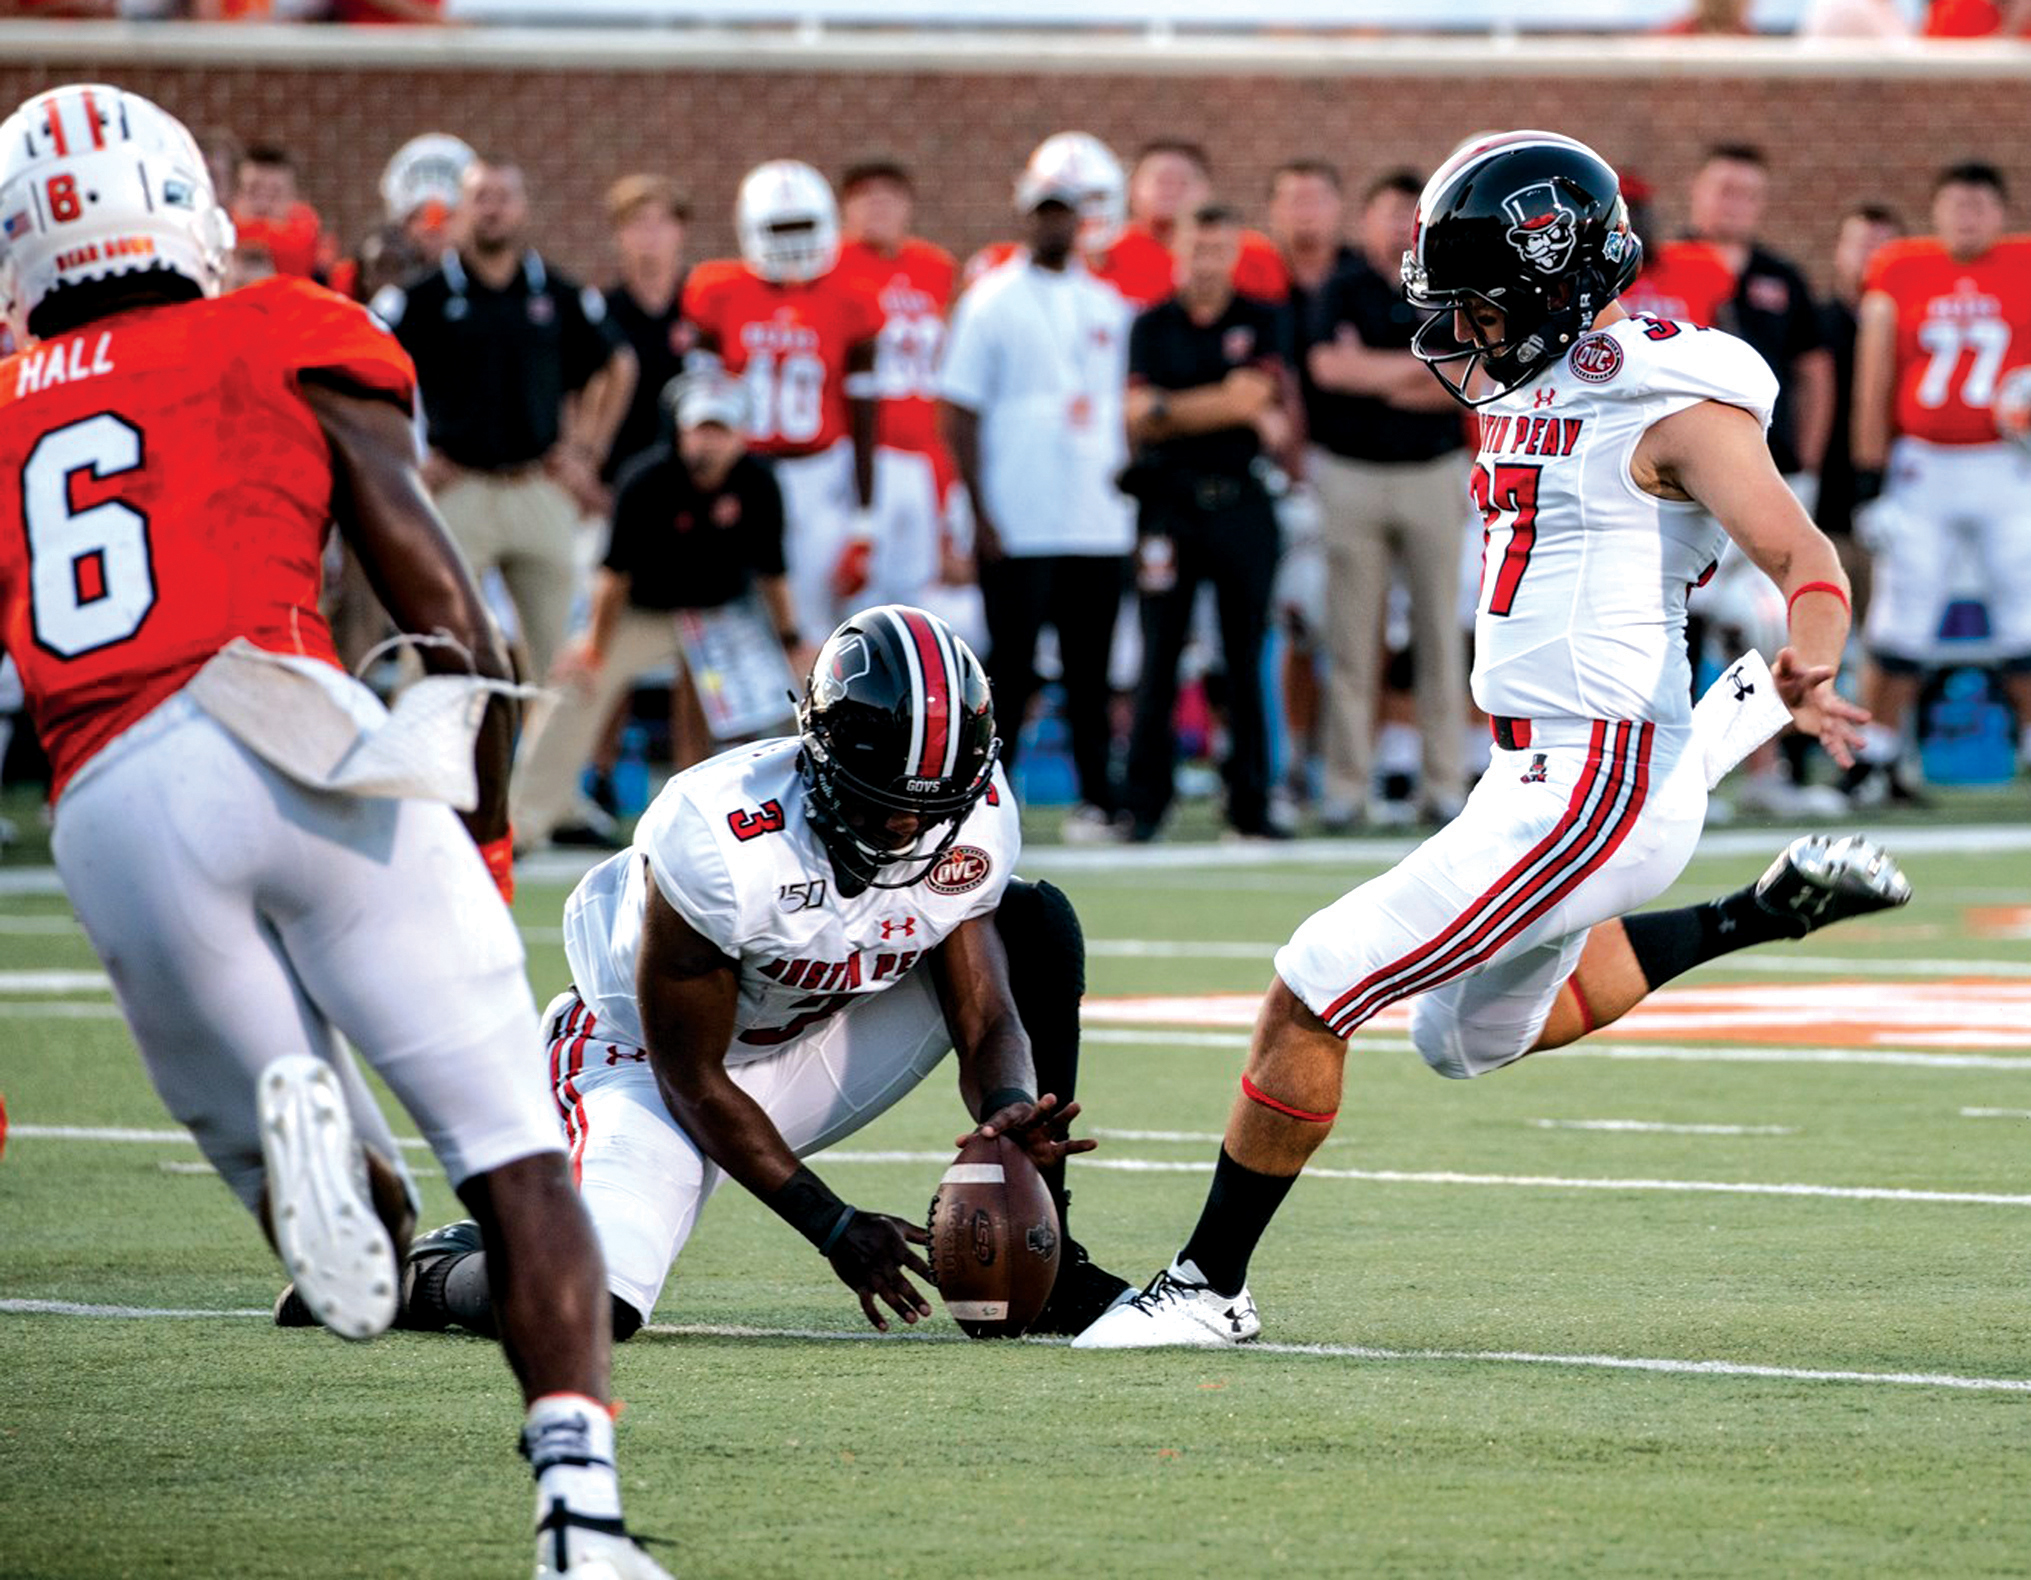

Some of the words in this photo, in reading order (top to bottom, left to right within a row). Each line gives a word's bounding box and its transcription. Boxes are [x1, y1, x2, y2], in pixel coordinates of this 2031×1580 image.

[15, 331, 115, 398] HALL
[1916, 319, 2012, 409] 77
[1510, 416, 1584, 457] PEAY
[20, 410, 159, 662] 6
[906, 779, 940, 793] GOVS
[727, 798, 785, 842] 3
[938, 859, 981, 883] OVC
[779, 879, 827, 914] 150
